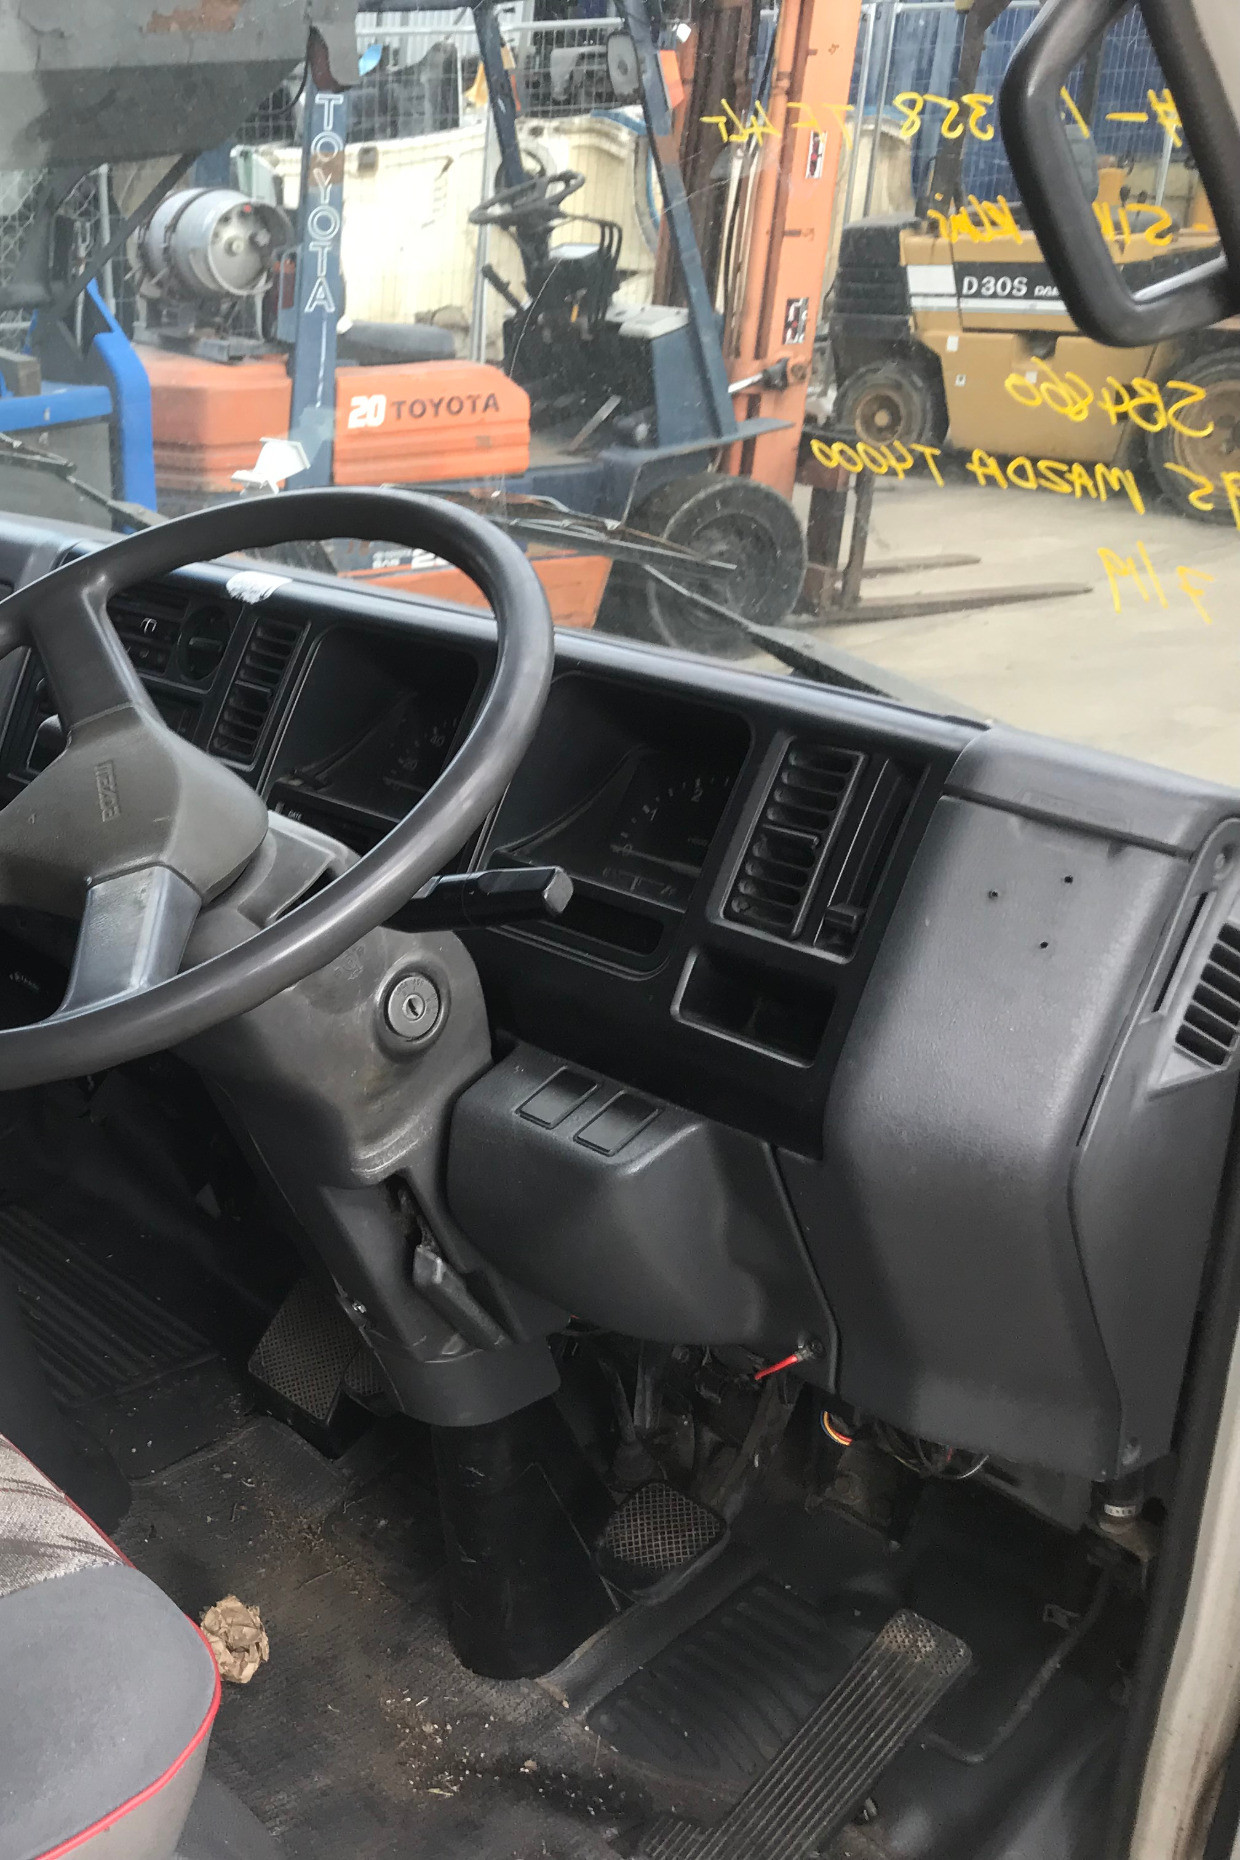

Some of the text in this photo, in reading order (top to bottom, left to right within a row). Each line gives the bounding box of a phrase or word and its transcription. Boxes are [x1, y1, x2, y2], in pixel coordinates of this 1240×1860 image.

[304, 93, 344, 313] TOYOTA
[962, 276, 1027, 297] D30S
[348, 393, 500, 429] 20 TOYOTA
